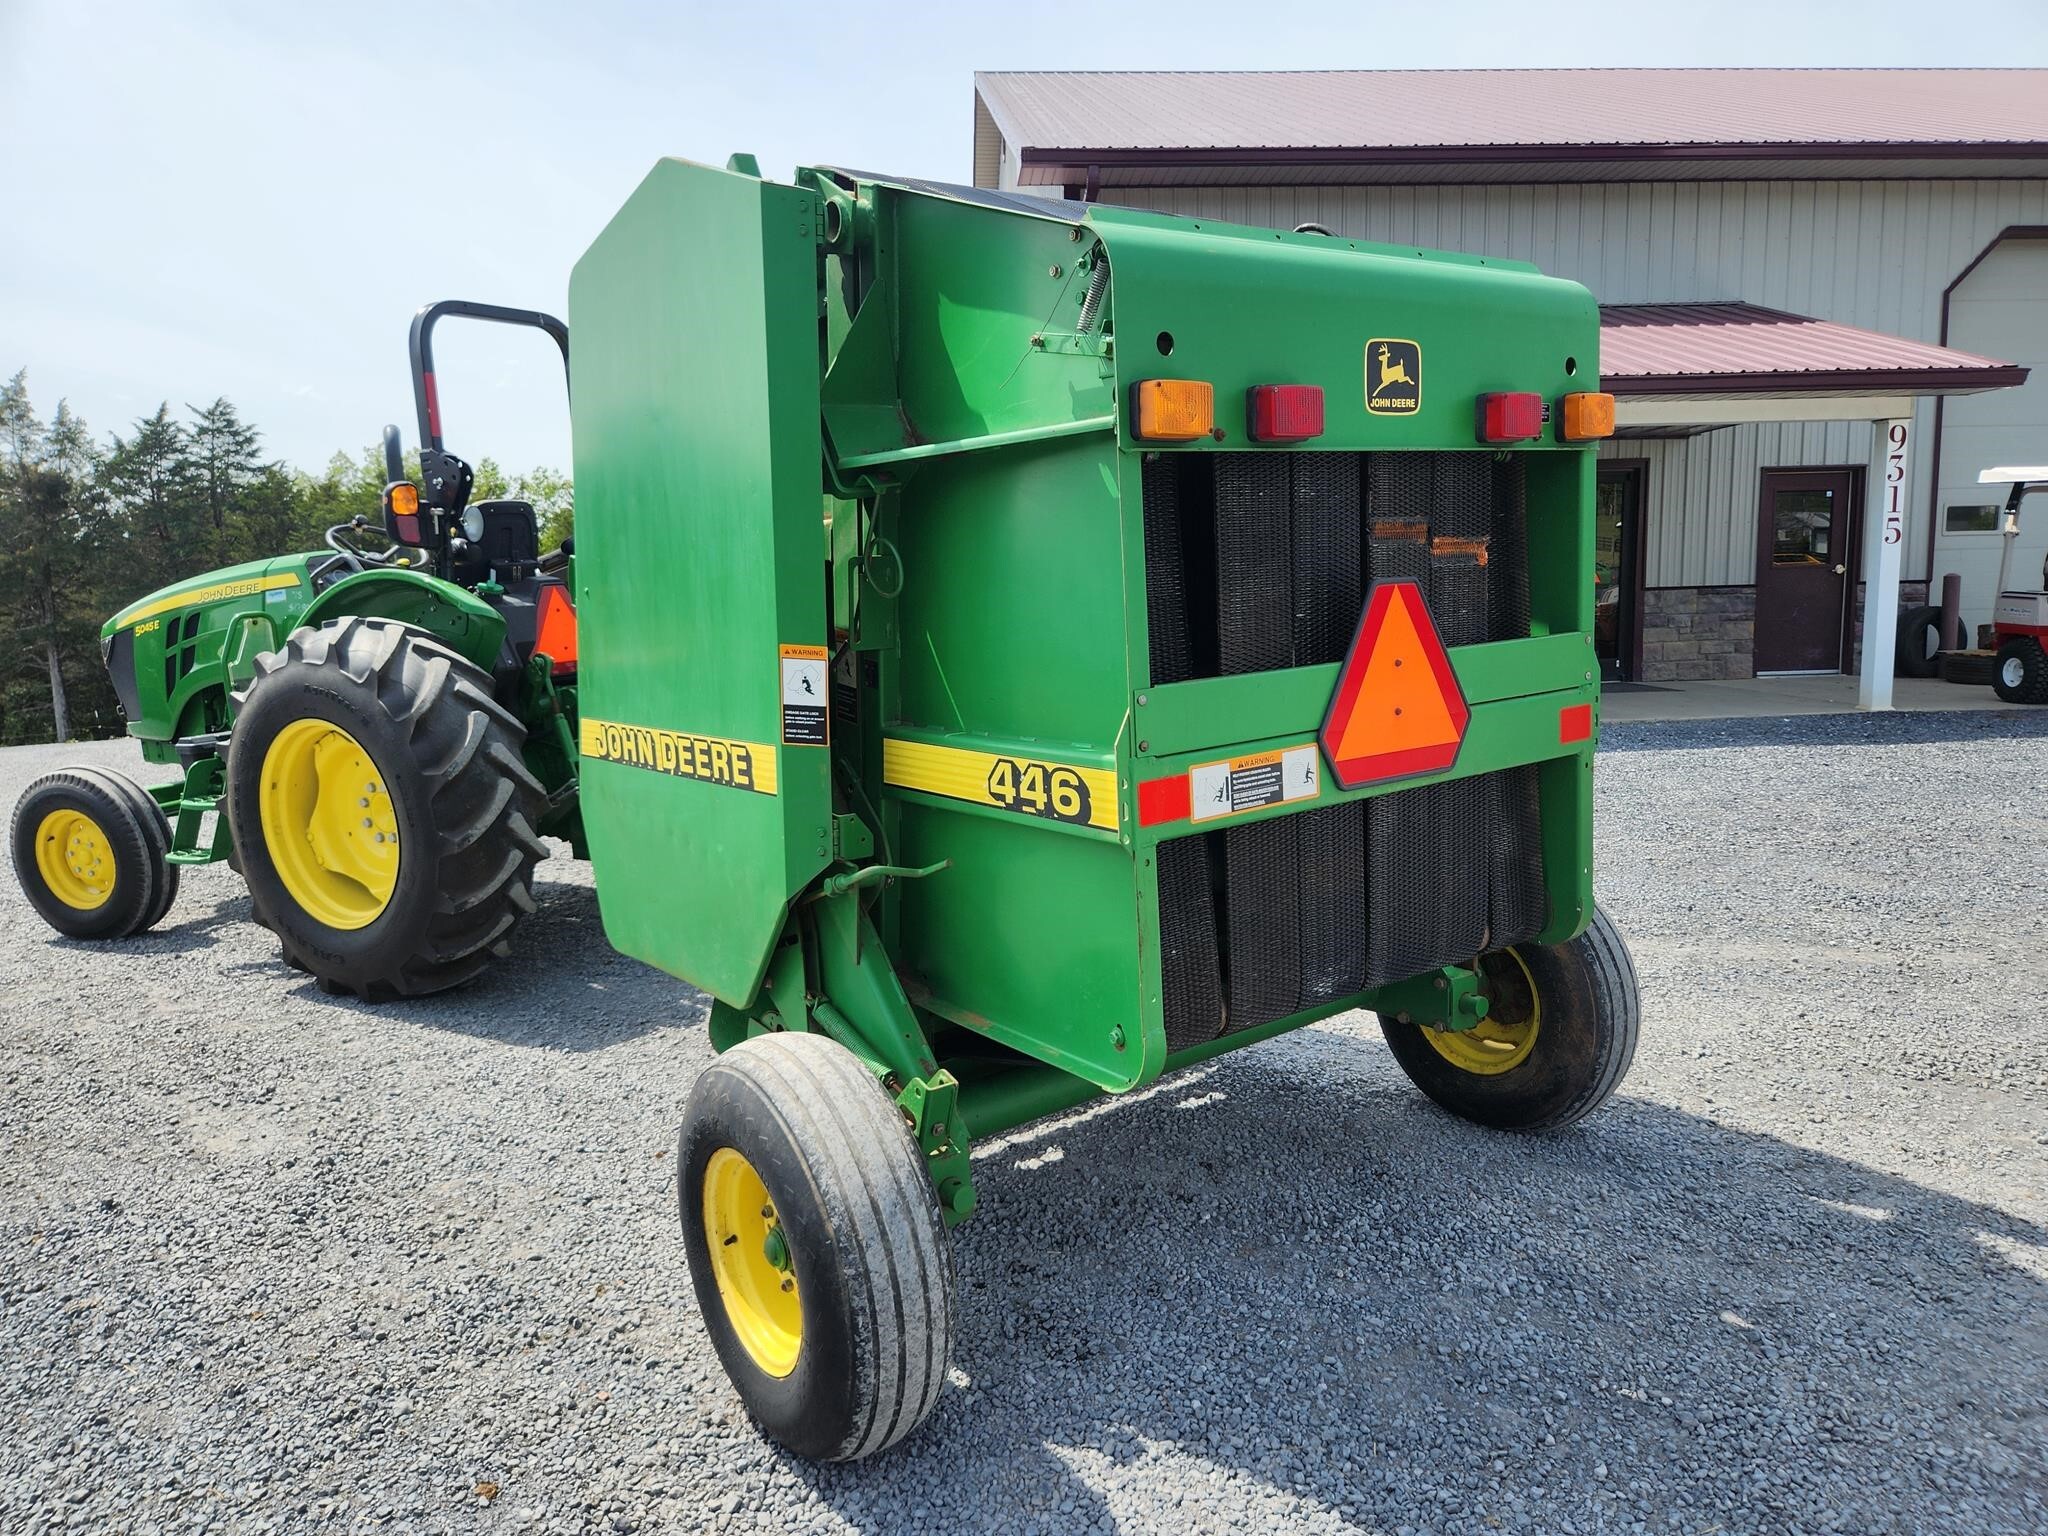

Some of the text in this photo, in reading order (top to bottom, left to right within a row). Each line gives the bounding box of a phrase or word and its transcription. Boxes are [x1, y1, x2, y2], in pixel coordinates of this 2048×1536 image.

[1370, 398, 1416, 408] JOHN DEERE
[1884, 424, 1907, 544] 9315
[199, 589, 223, 602] JOHN
[225, 583, 260, 597] DEERE
[791, 649, 824, 657] WARNING
[596, 723, 753, 788] JOHN DEERE
[1243, 755, 1275, 768] WARNING
[988, 758, 1089, 822] 446
